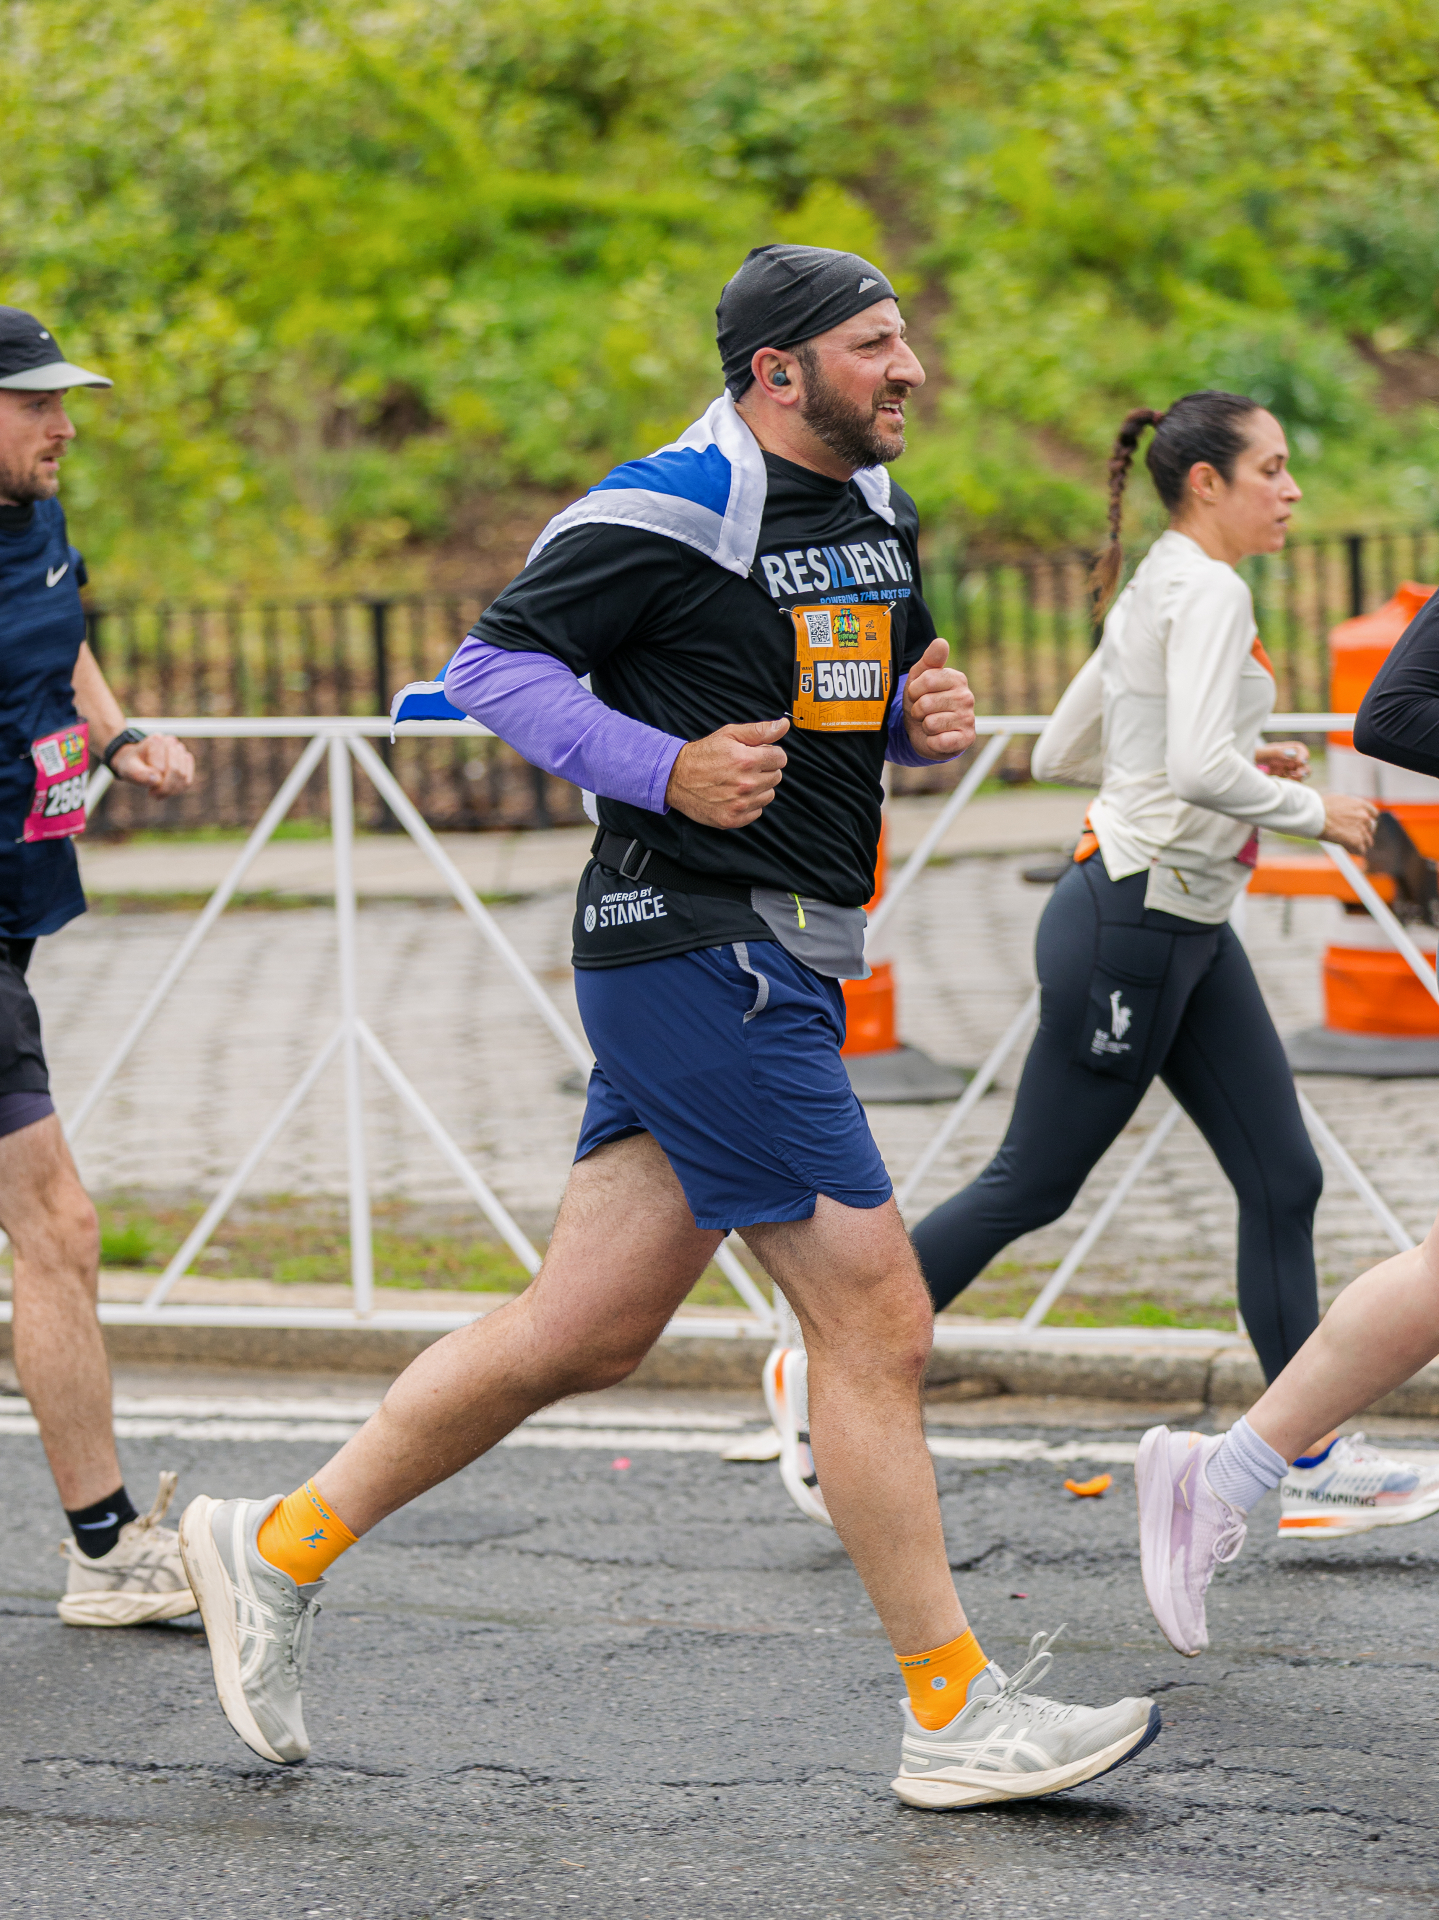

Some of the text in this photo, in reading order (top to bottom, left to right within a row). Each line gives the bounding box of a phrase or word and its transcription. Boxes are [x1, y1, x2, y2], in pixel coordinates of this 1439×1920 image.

[898, 588, 911, 598] STEP
[800, 672, 813, 694] 5
[816, 661, 880, 699] 56007
[601, 886, 653, 904] POWERED BY
[600, 894, 668, 928] STANCE
[1283, 1485, 1376, 1507] ON RUNNING
